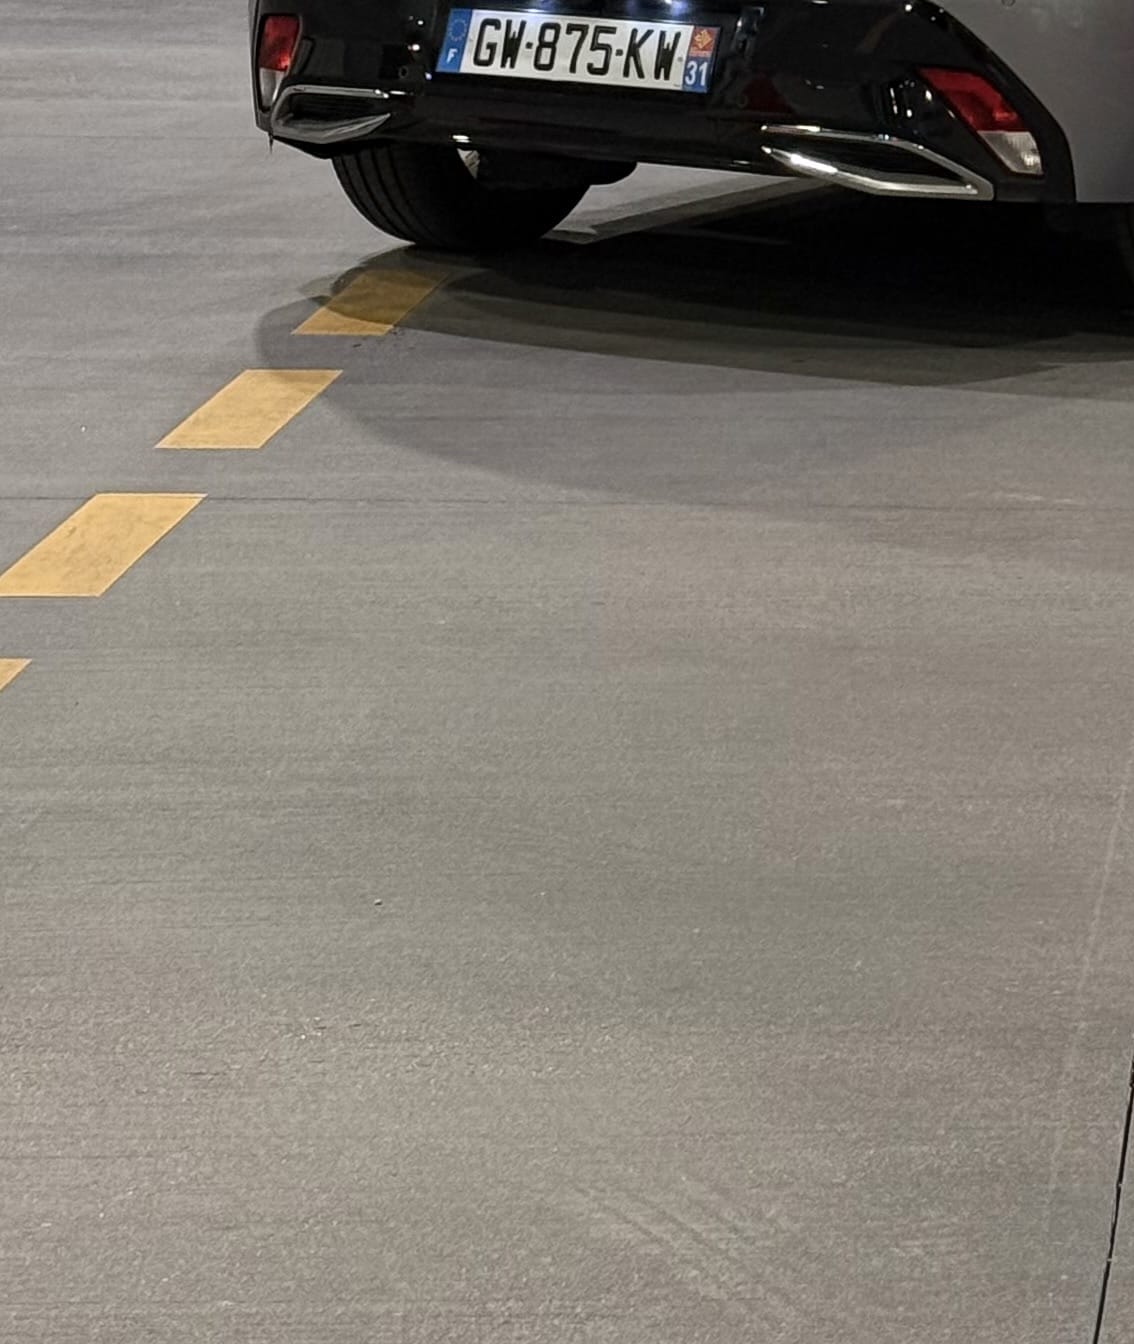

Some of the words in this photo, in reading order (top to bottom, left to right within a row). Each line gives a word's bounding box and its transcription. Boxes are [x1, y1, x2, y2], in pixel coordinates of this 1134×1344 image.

[446, 48, 457, 64] F
[473, 17, 682, 82] GW-875-KW
[684, 60, 709, 87] 31
